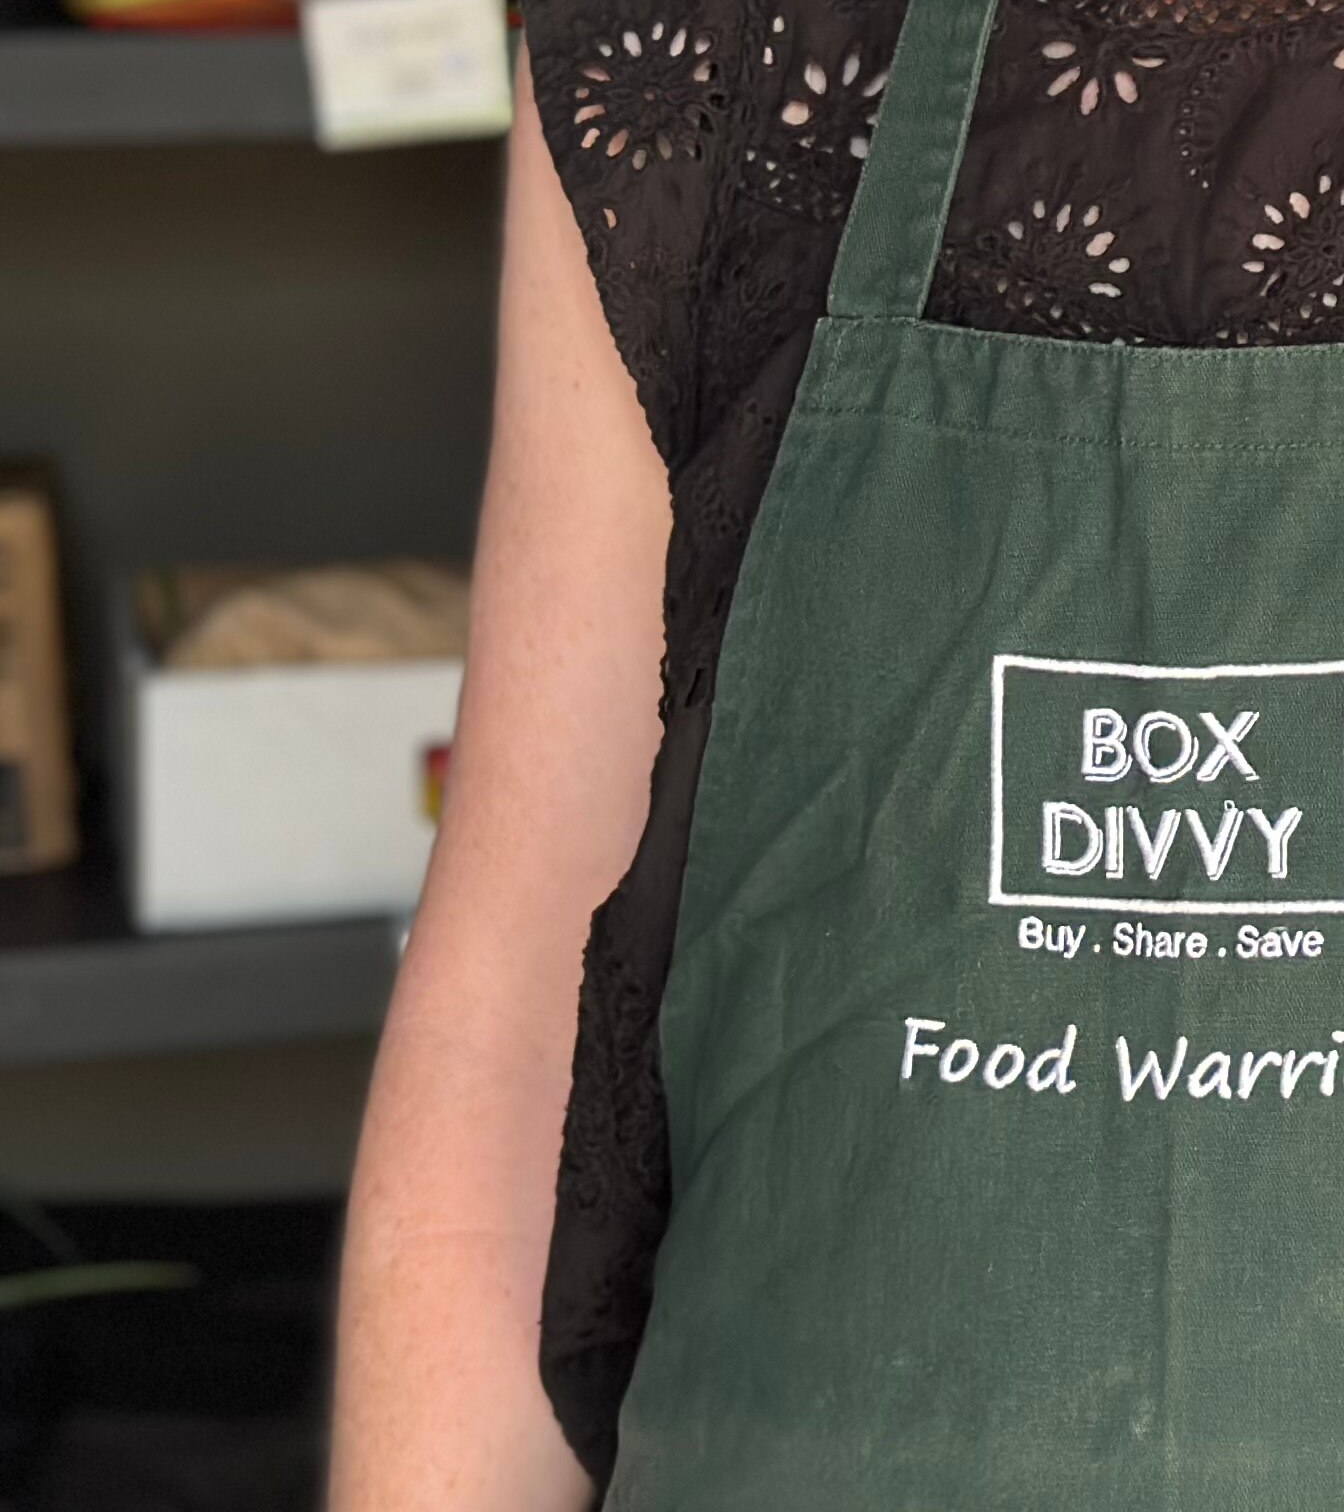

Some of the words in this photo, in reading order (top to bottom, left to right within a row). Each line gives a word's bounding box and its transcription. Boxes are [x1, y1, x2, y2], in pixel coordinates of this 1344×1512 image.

[1080, 707, 1260, 783] BOX
[1041, 800, 1303, 881] DIVVY
[1018, 915, 1087, 959] Buy
[1112, 922, 1209, 959] Share
[1235, 924, 1326, 959] Save
[901, 1017, 1078, 1095] Food
